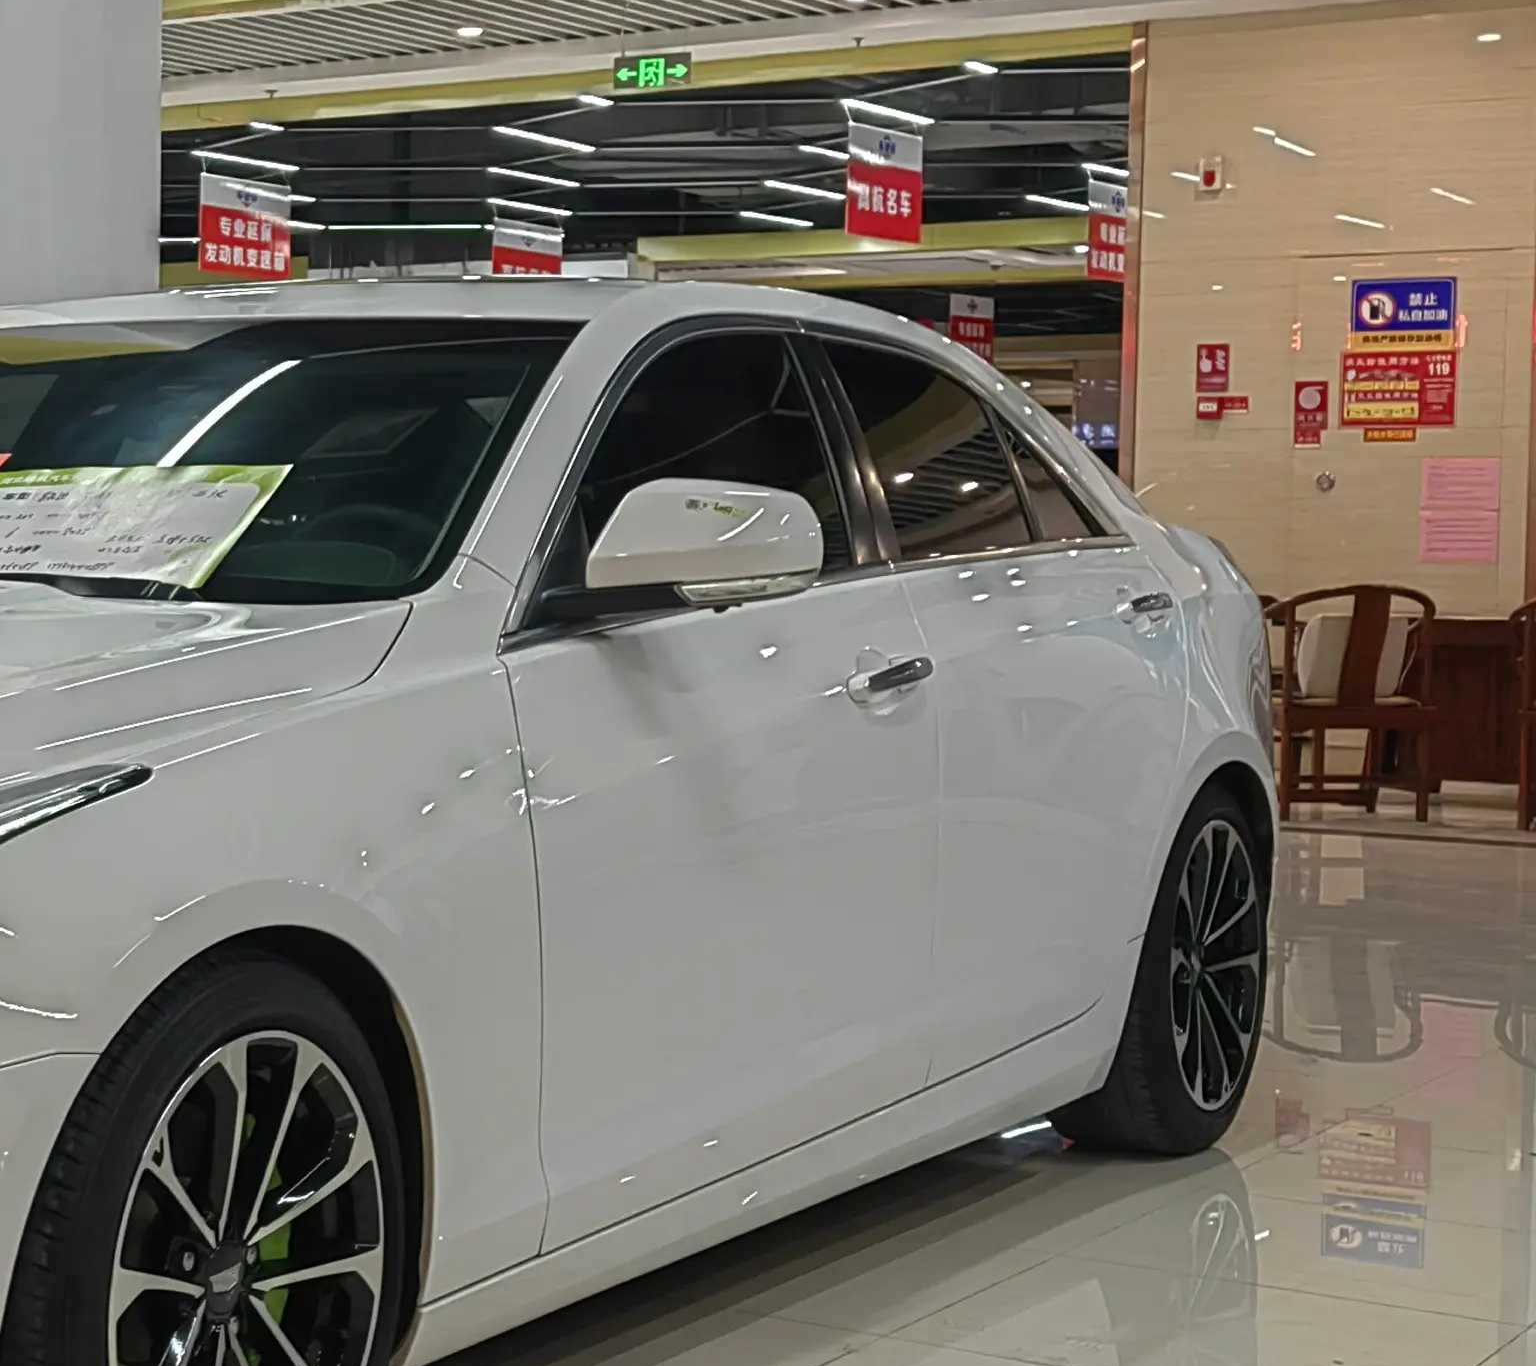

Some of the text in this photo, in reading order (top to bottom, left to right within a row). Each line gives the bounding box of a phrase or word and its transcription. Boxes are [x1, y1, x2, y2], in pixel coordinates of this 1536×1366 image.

[204, 242, 286, 272] 发动机变速箱
[1408, 292, 1438, 307] 禁止
[1428, 362, 1451, 376] 119
